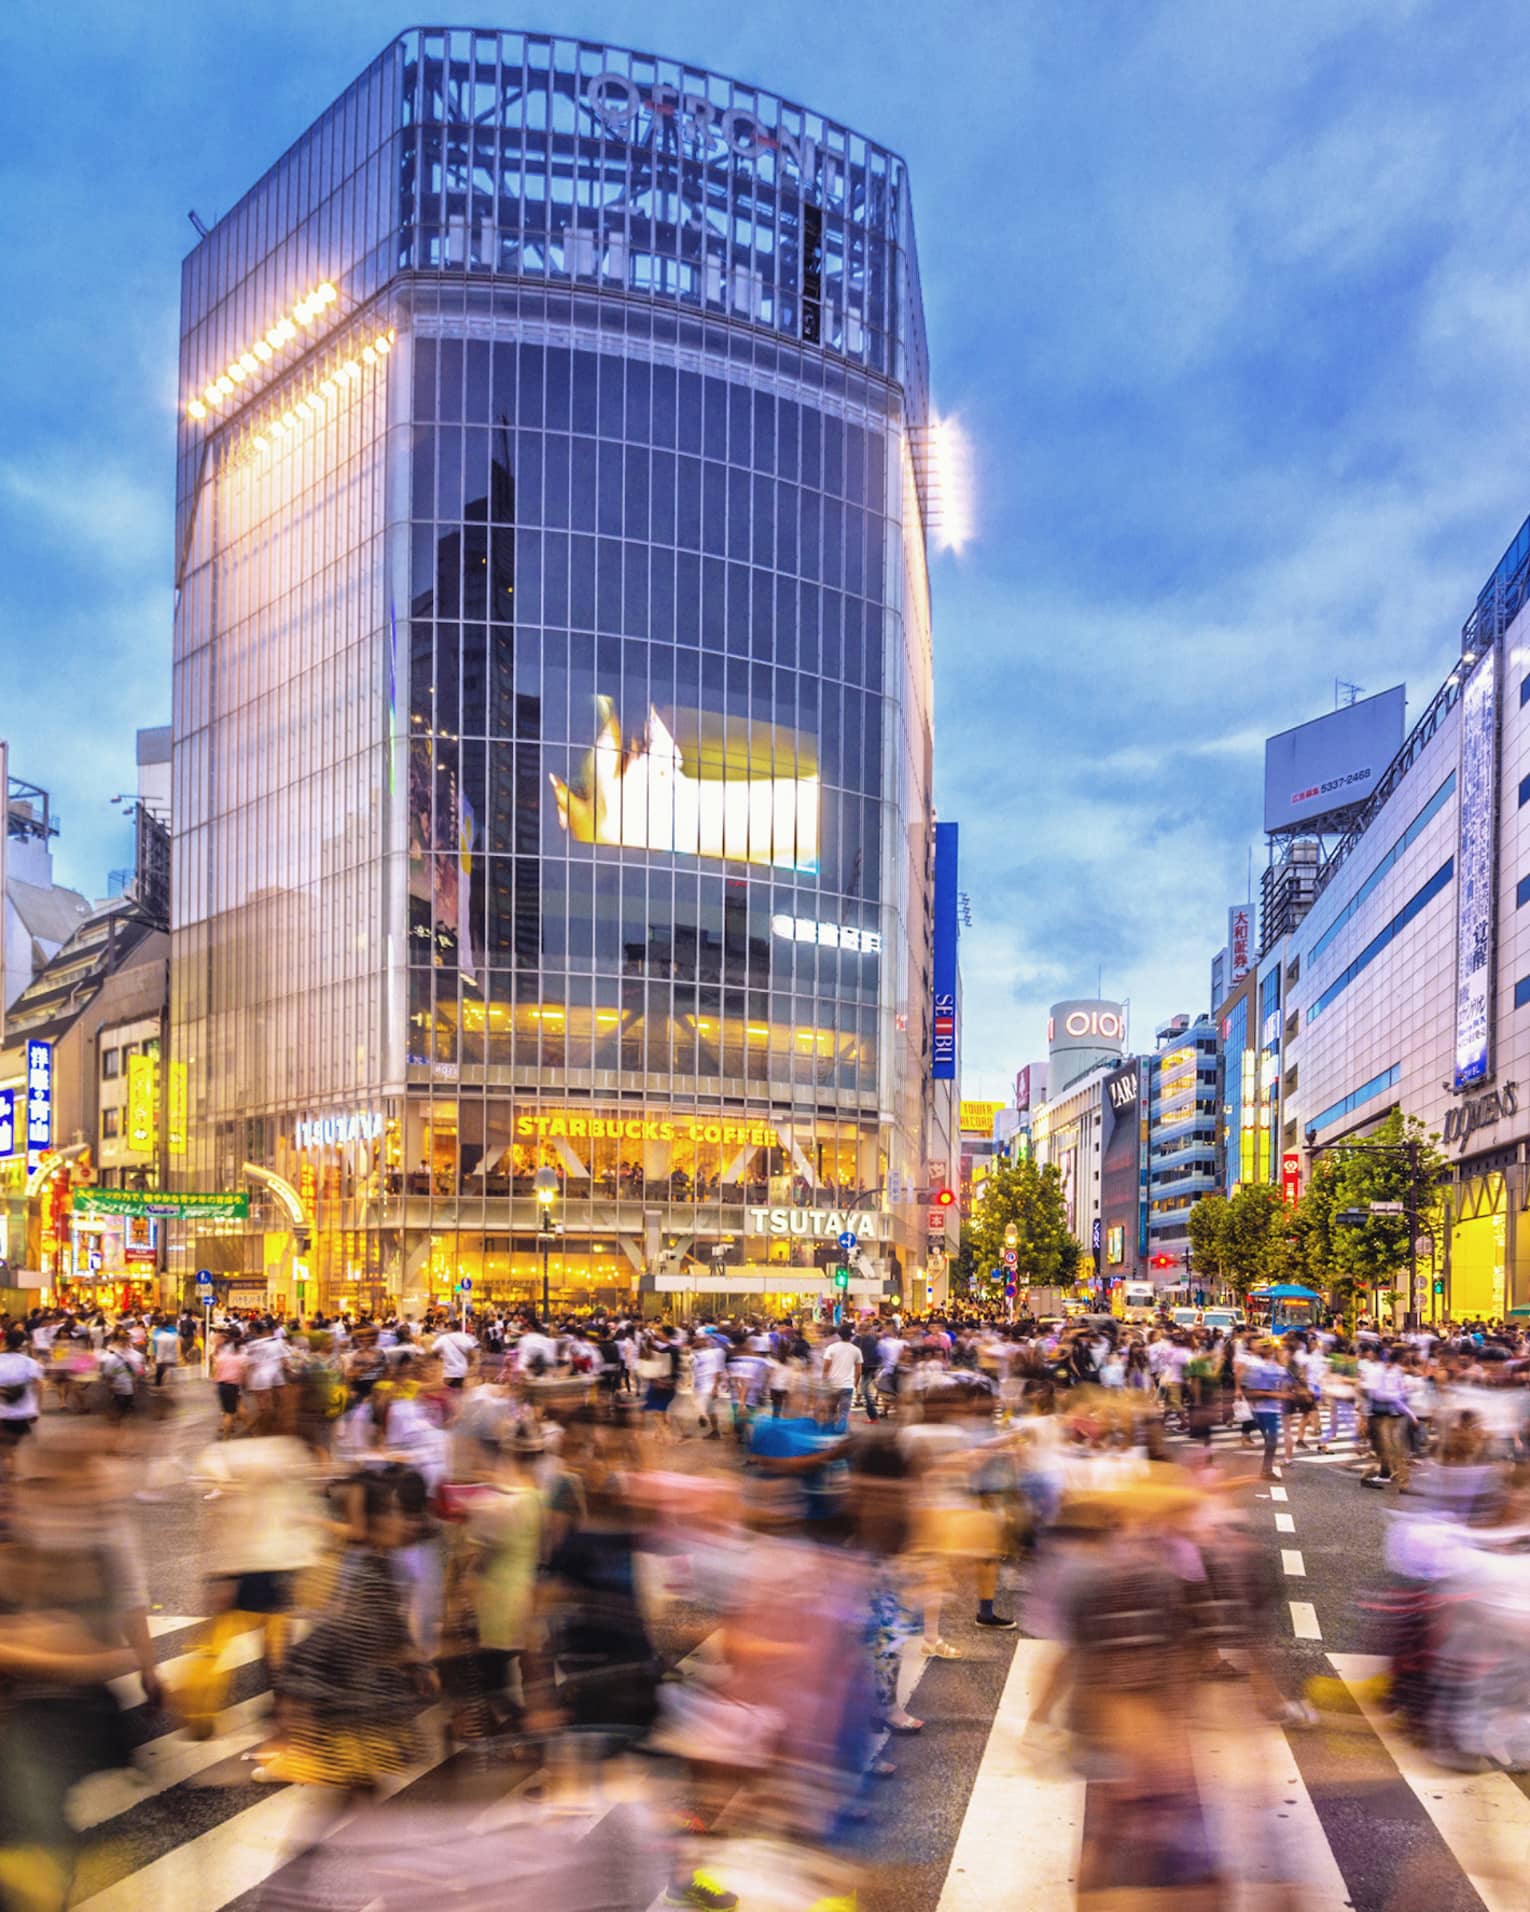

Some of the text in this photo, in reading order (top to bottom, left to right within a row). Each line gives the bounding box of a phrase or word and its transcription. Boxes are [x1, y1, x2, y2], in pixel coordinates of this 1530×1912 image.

[1233, 911, 1248, 968] 大和証券
[936, 994, 953, 1062] SEIBU
[517, 1116, 777, 1148] STARBUCKS COFFEE
[750, 1208, 876, 1238] TSUTAYA
